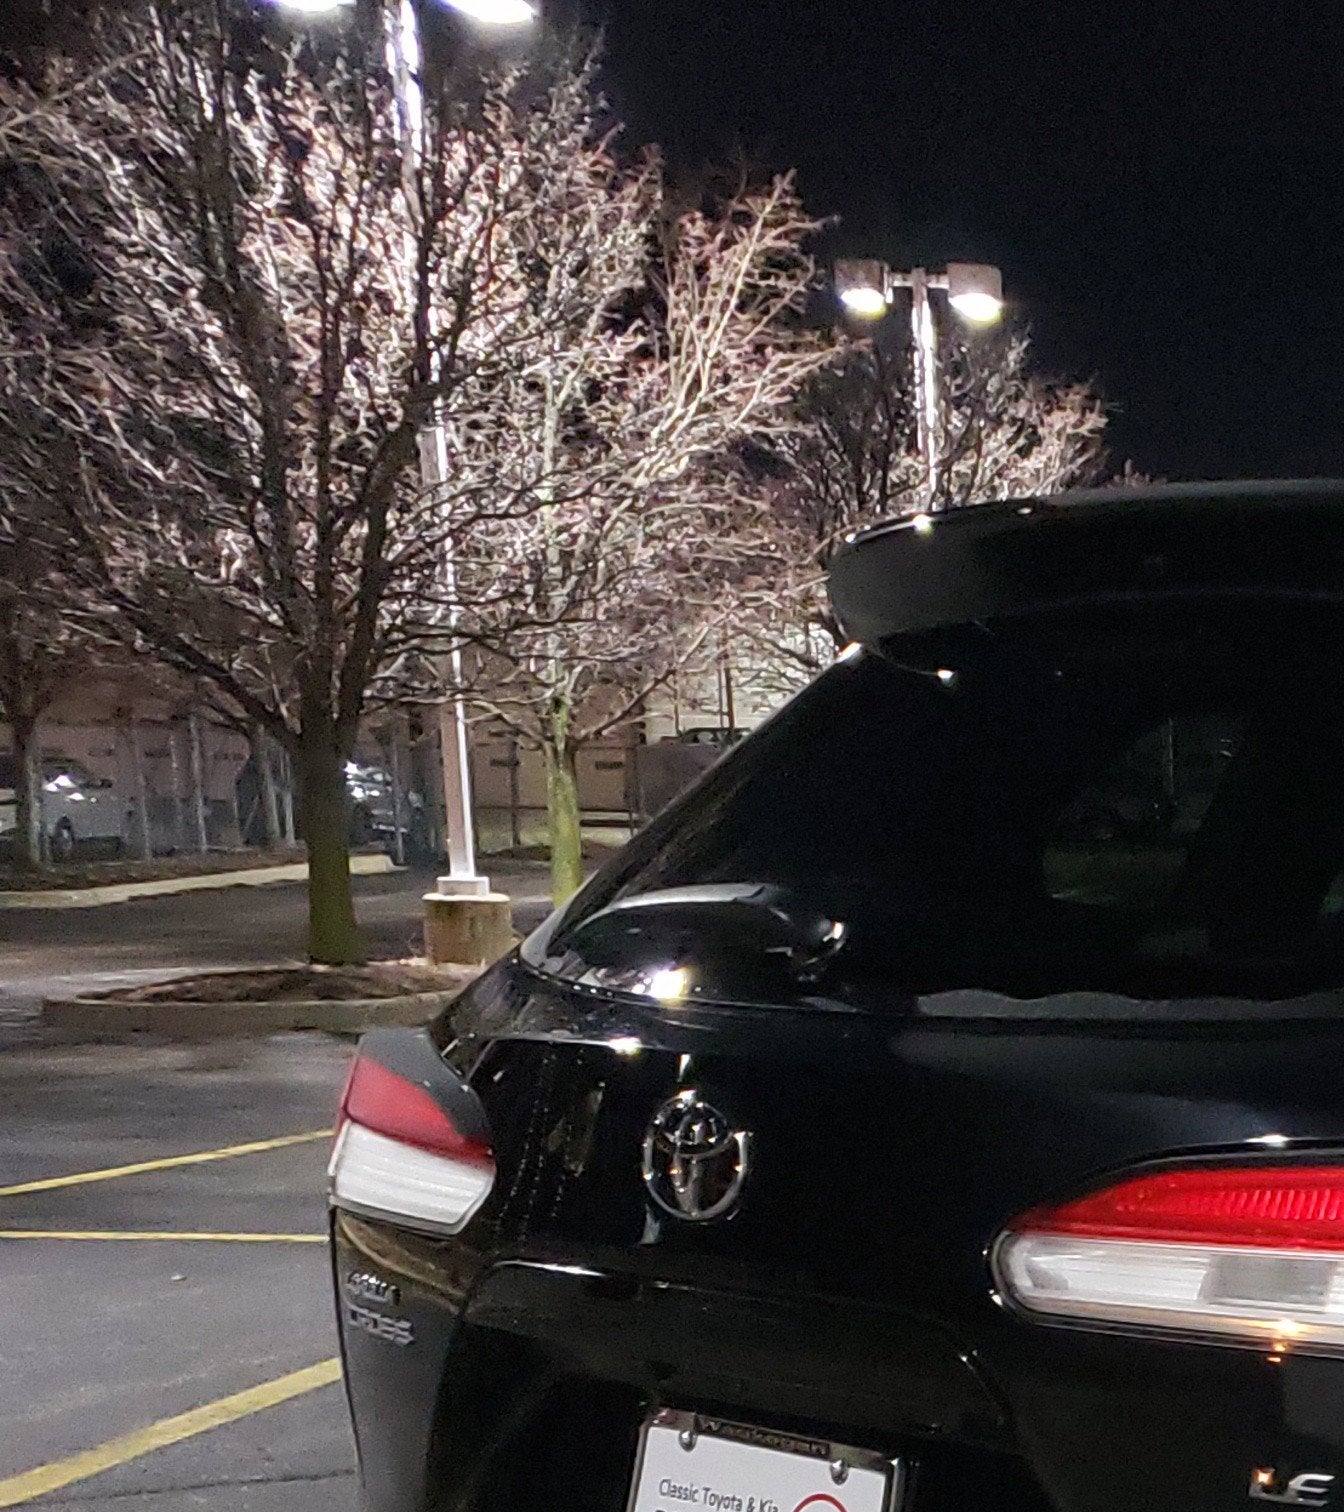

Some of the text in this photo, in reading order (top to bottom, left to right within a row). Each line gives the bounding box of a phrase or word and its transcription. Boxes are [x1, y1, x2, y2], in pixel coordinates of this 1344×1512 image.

[659, 1479, 698, 1502] Classic
[702, 1486, 743, 1512] Toyota
[1249, 1467, 1335, 1507] LE
